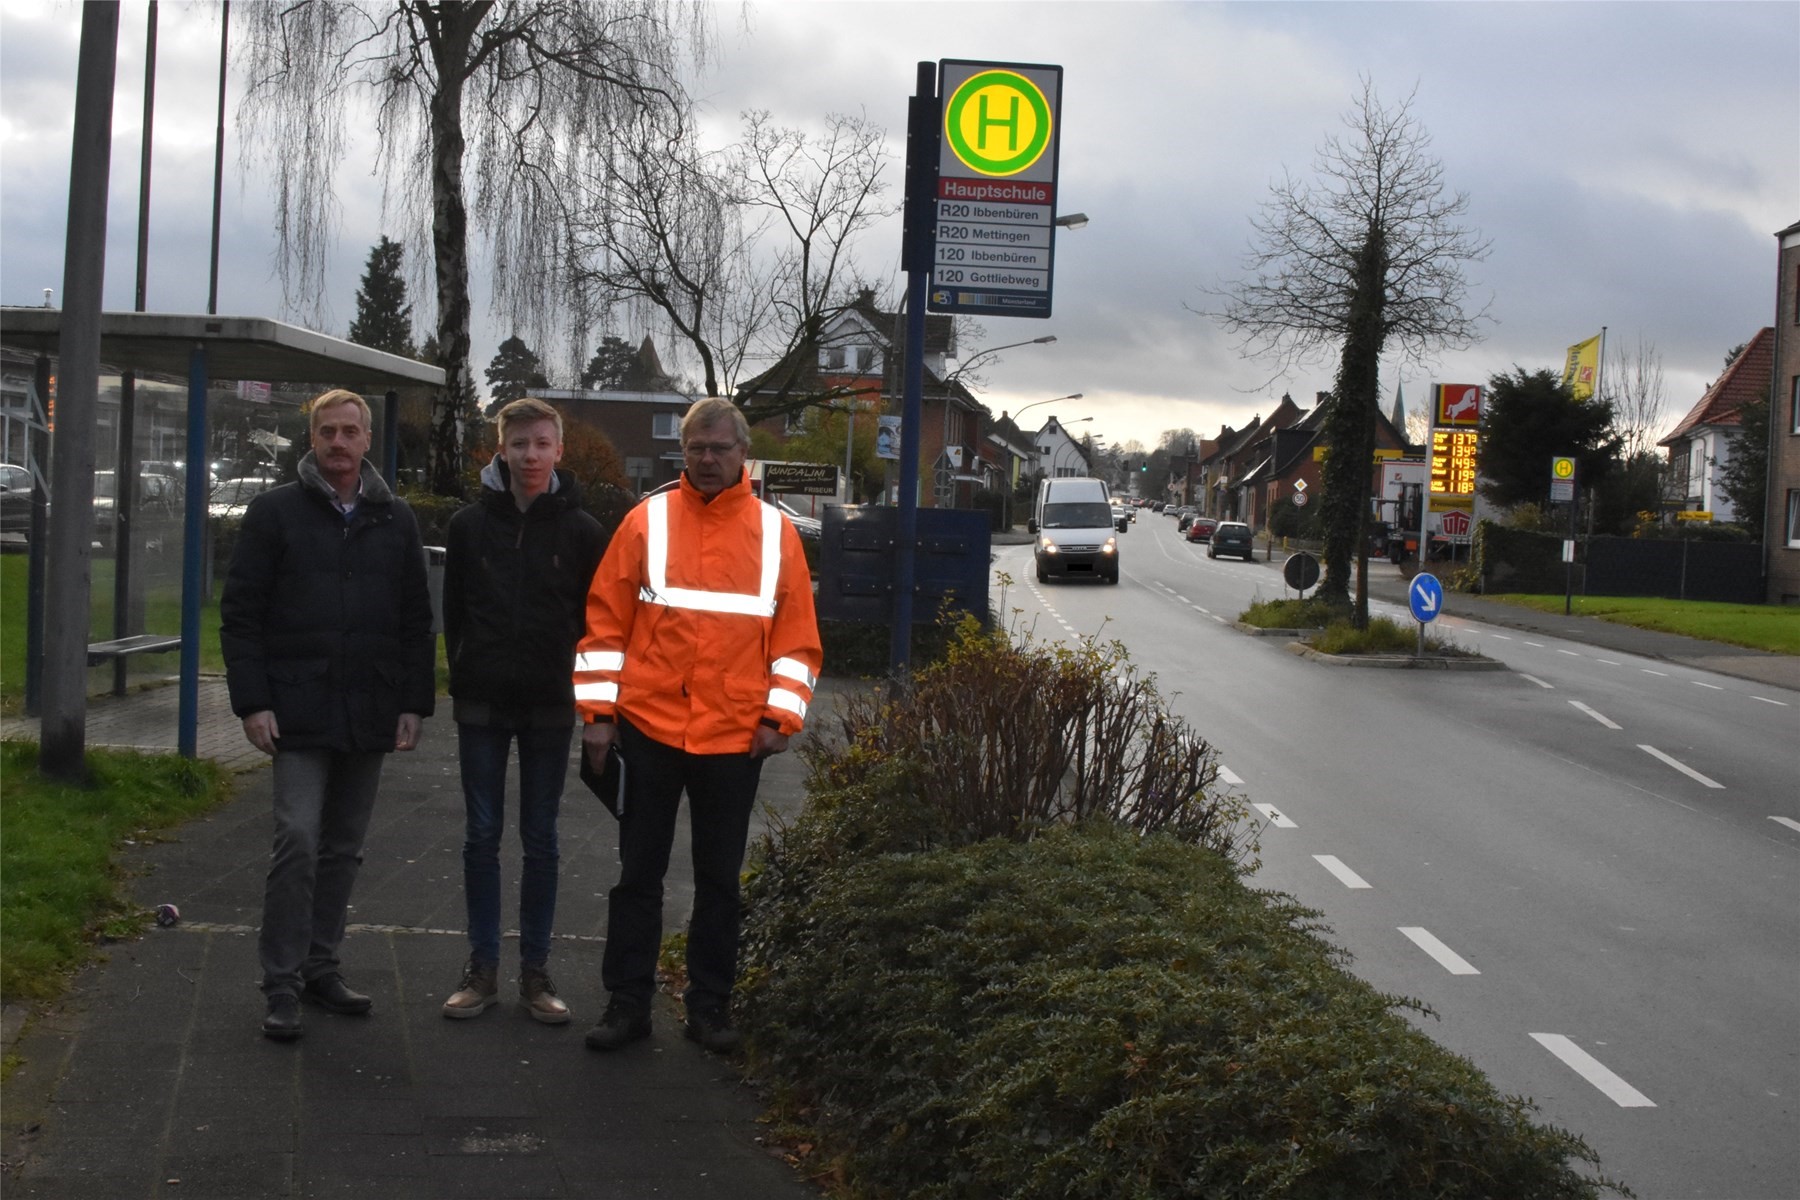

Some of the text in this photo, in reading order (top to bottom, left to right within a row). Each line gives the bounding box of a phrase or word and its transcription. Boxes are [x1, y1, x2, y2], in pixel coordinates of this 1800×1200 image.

[978, 95, 1019, 151] H
[944, 182, 1046, 200] Hauptschule
[940, 204, 1039, 220] R20 Ibbenbüren
[939, 225, 1030, 243] R20 Mettingen
[938, 247, 1037, 263] 120 Ibbenbüren
[938, 269, 1040, 288] 120 Gottliebweg
[766, 465, 826, 478] KUNDALINI
[1450, 470, 1475, 481] 1199
[804, 486, 834, 494] FRISEUR
[1294, 494, 1305, 503] 50
[1442, 511, 1471, 536] UTA
